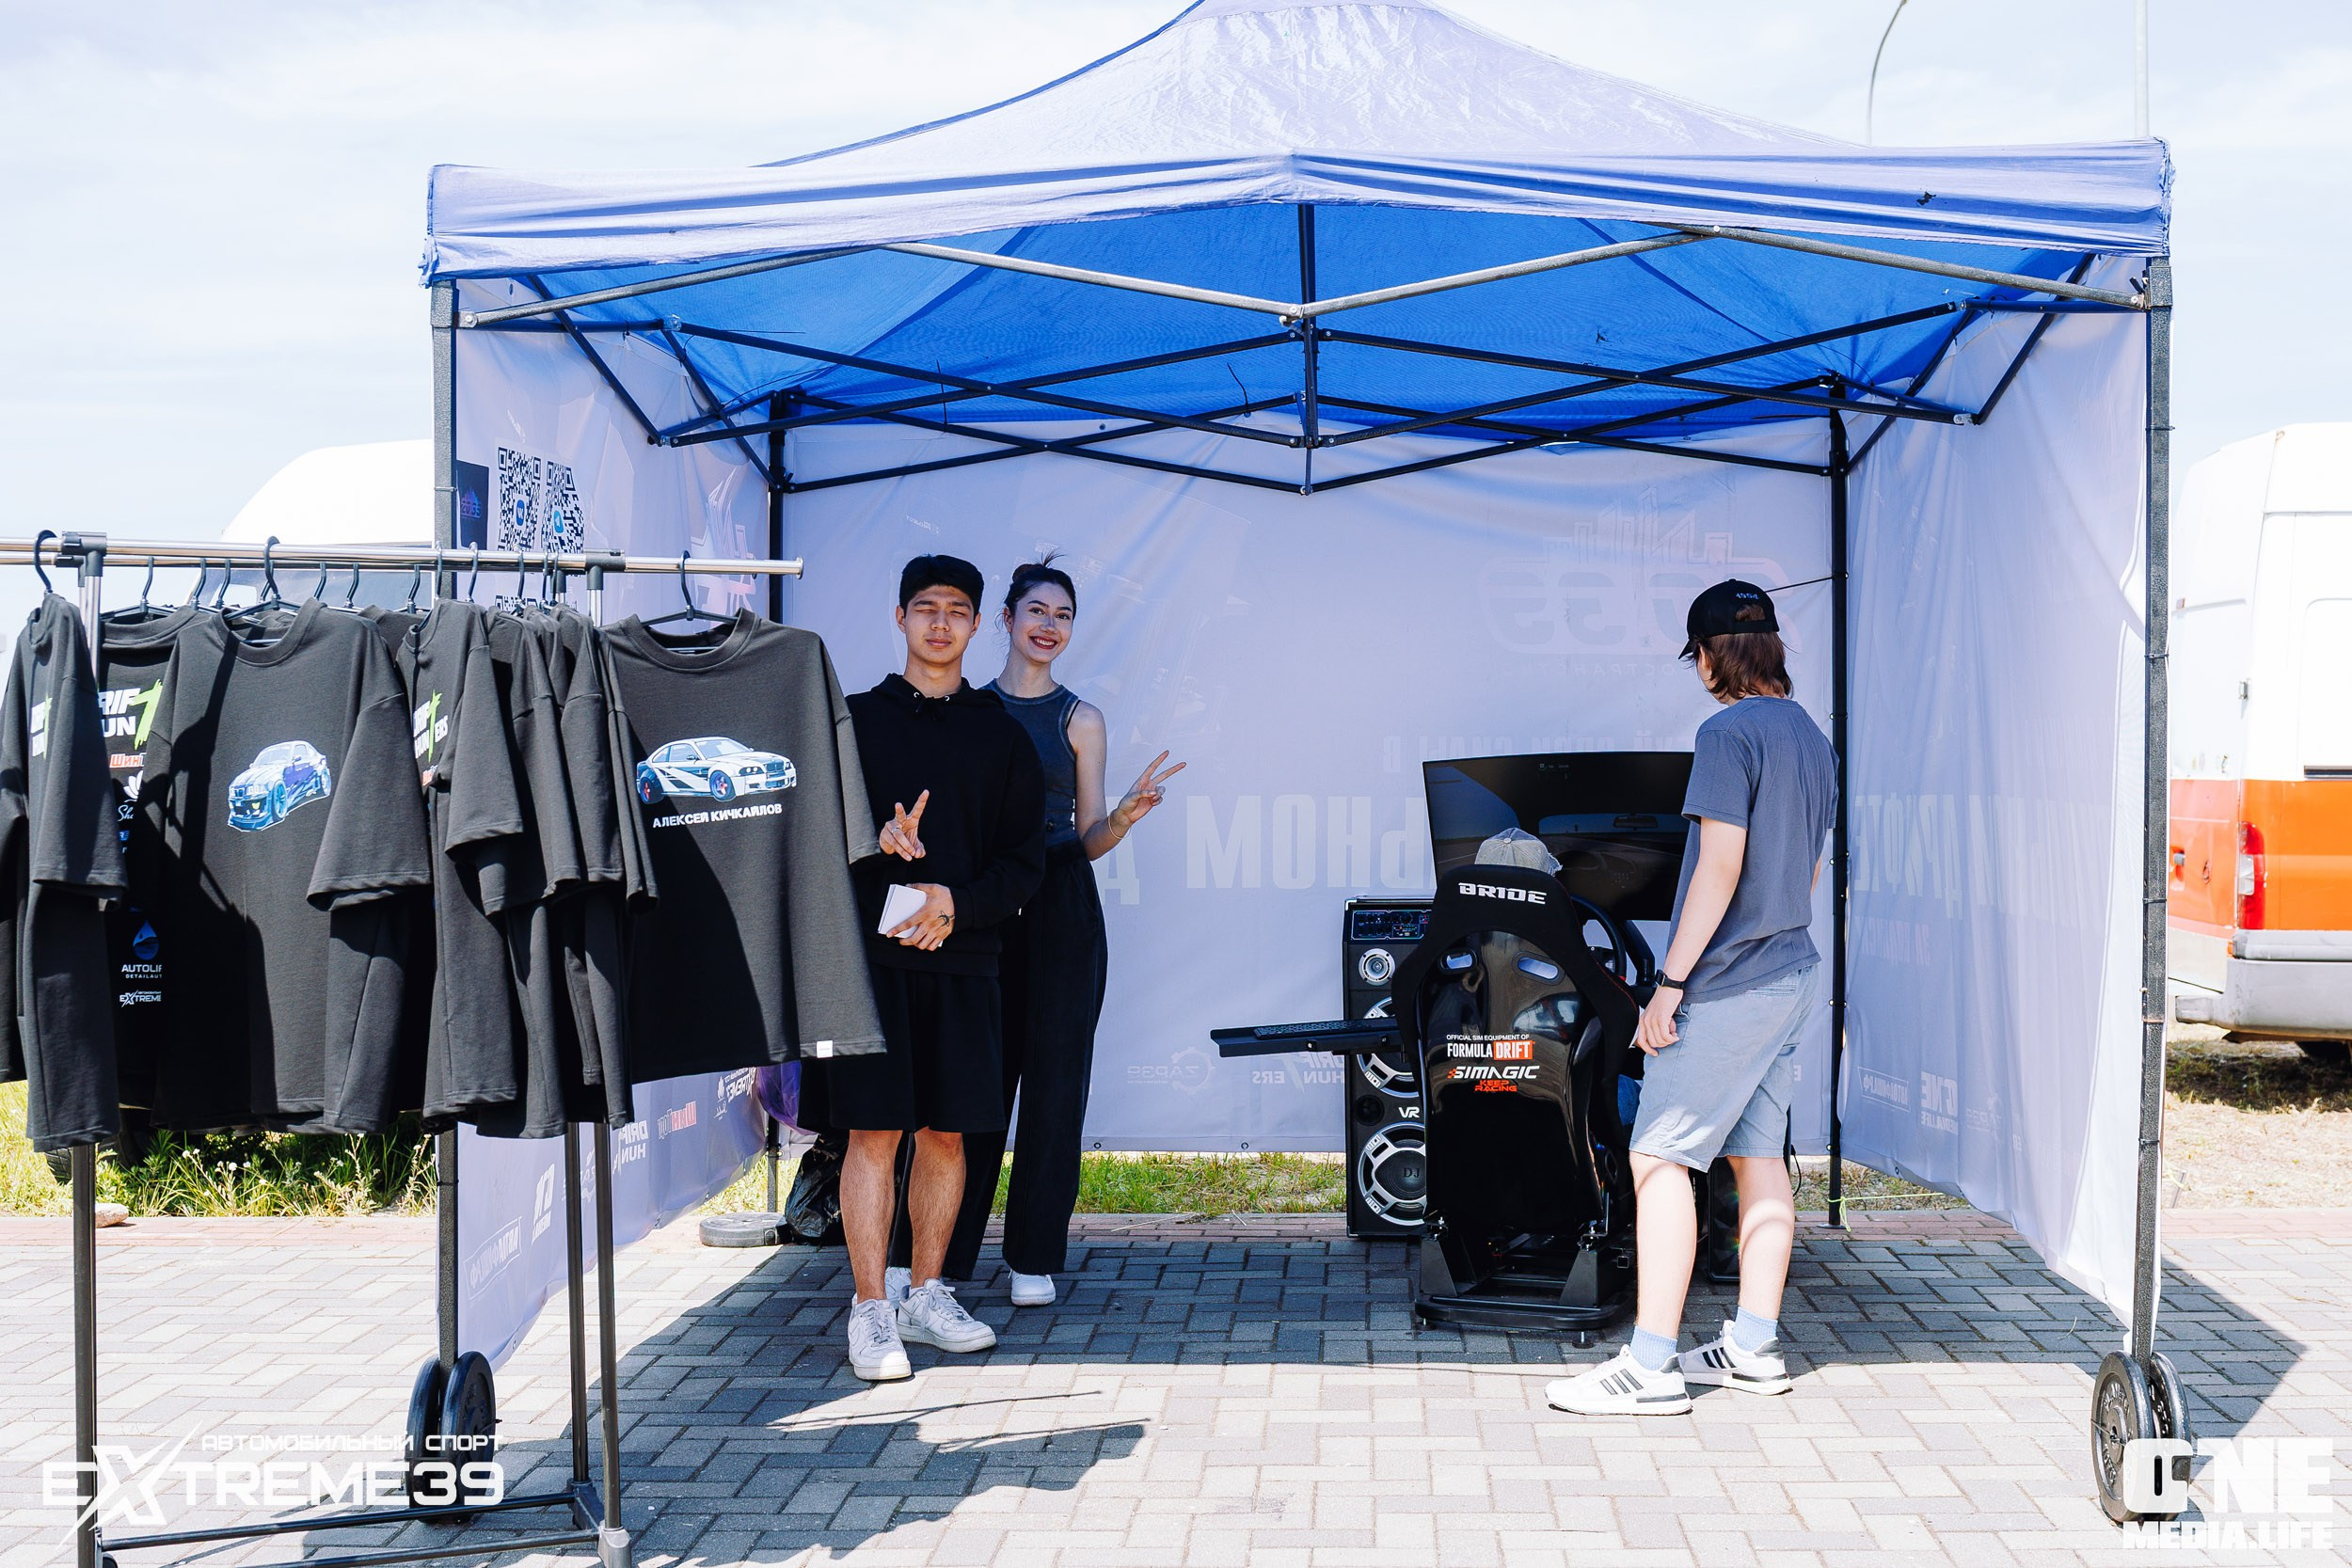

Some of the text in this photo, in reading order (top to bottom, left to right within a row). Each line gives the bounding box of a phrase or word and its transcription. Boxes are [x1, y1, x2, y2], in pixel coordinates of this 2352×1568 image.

[652, 803, 783, 829] АЛЕКСЕЙ КИЧКАЙЛОВ
[1457, 881, 1548, 905] BRIDE
[1447, 1041, 1531, 1059] FORMULA DRIFT
[1453, 1065, 1540, 1080] SIMAGIC
